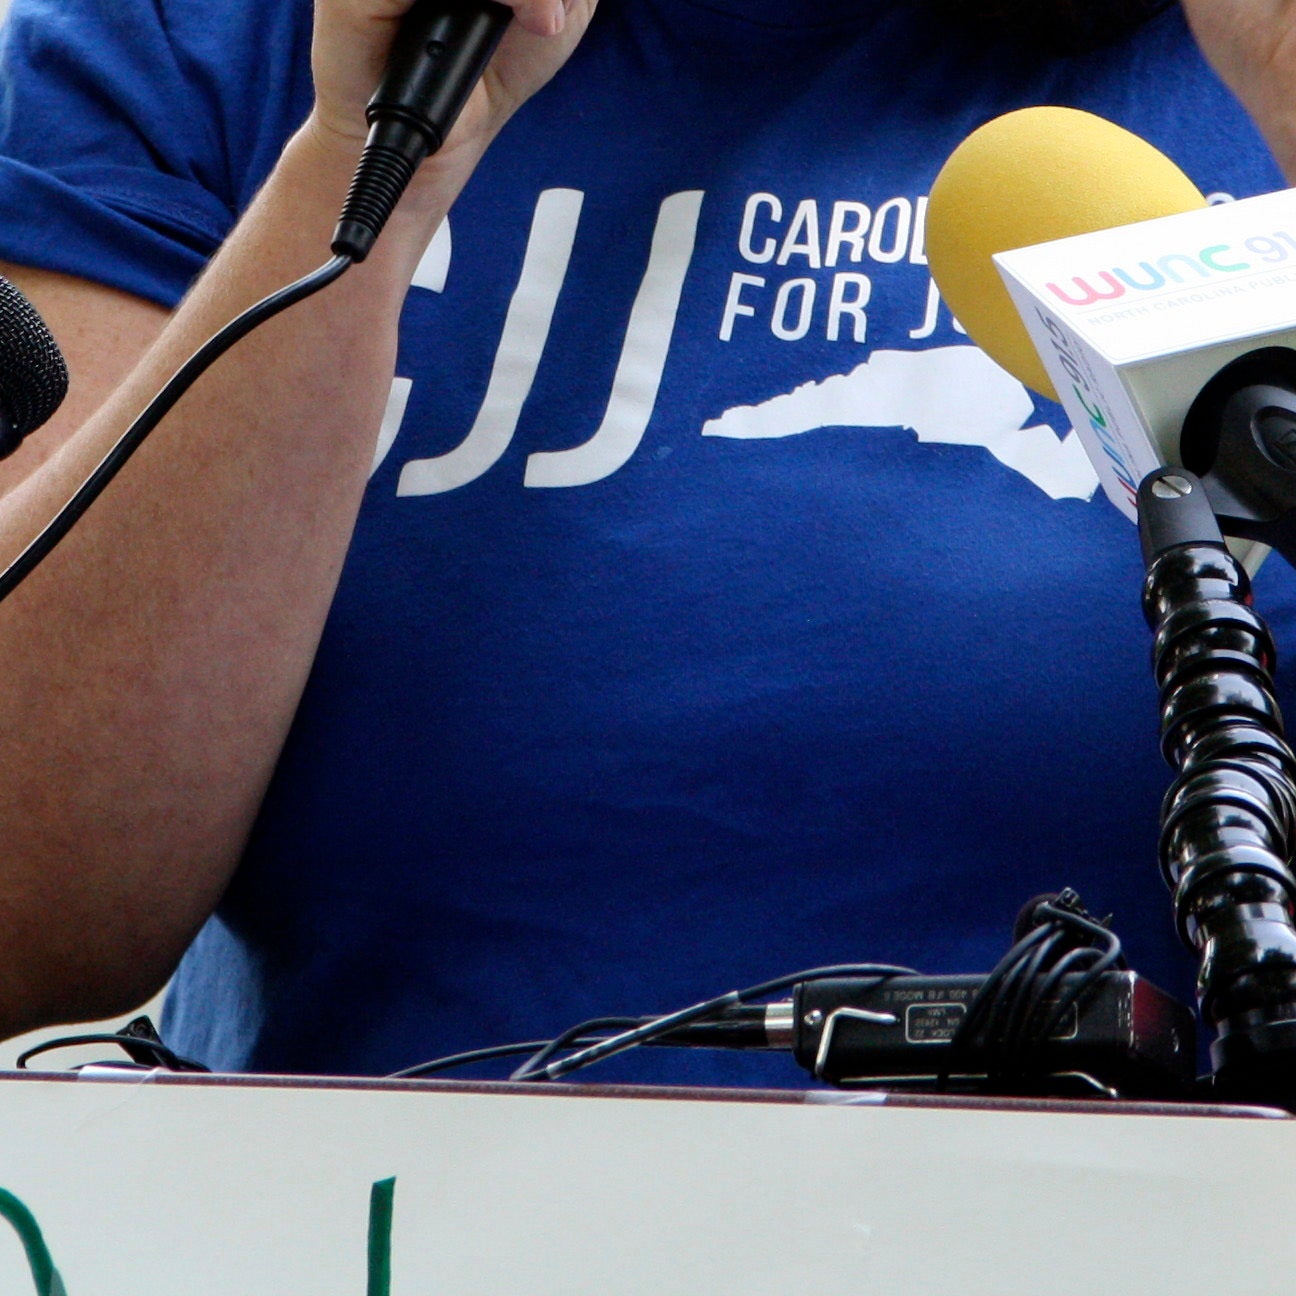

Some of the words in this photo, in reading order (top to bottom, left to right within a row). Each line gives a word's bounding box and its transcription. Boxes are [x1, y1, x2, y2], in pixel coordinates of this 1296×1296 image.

[738, 192, 930, 269] CAROL
[719, 271, 872, 344] FOR
[1045, 244, 1251, 307] wunc
[1086, 303, 1151, 328] NORTH
[1152, 283, 1247, 313] CAROLINA
